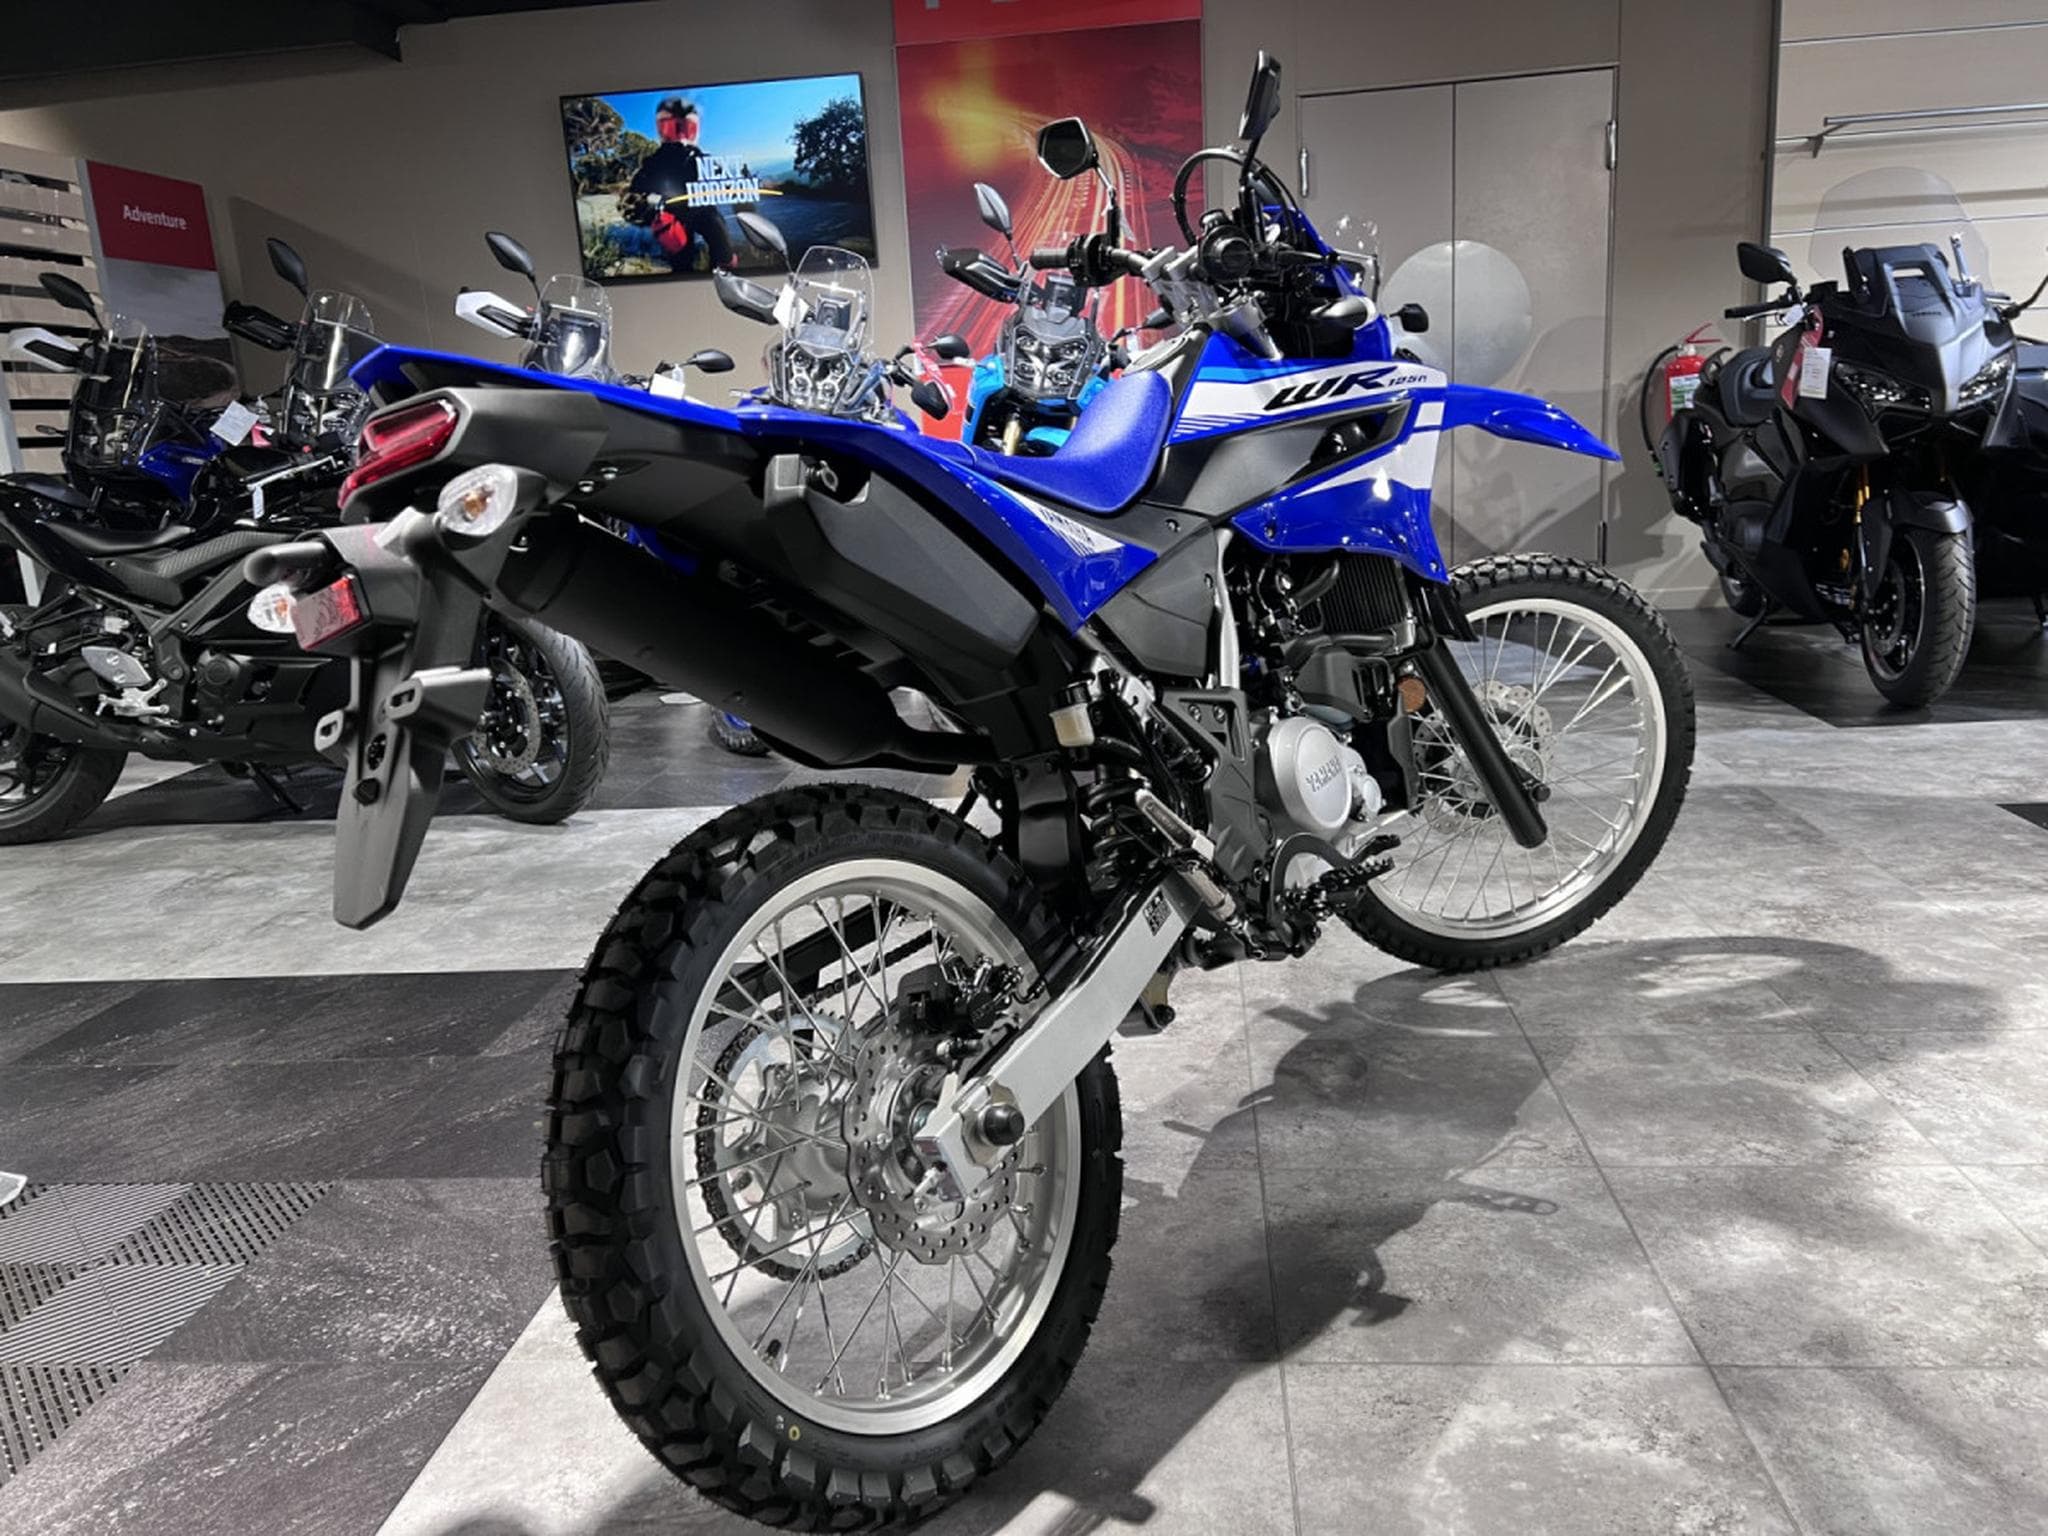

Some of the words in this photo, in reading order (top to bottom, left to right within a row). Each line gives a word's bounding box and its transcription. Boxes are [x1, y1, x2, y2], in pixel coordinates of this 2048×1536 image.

[696, 155, 744, 181] NEXT
[686, 178, 761, 207] HORIZON
[122, 205, 187, 230] Adventure
[1263, 366, 1398, 410] WR
